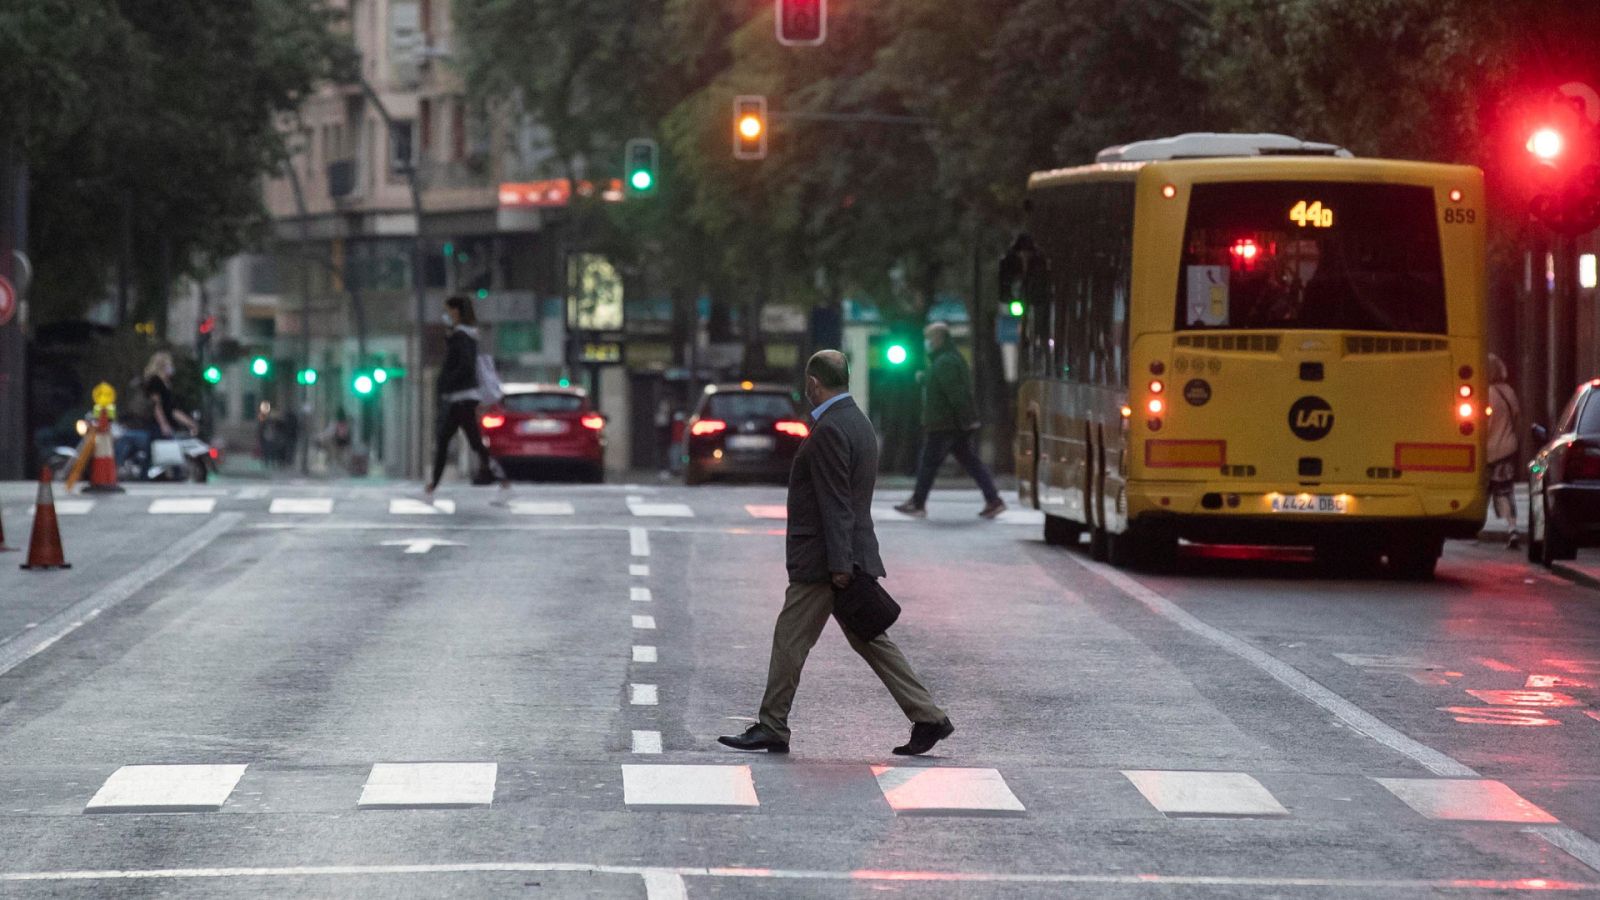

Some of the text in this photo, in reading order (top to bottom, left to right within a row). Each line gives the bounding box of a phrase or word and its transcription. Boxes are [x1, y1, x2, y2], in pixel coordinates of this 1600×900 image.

[1444, 208, 1475, 224] 859
[1296, 410, 1331, 427] LAT
[1282, 497, 1314, 510] 4424
